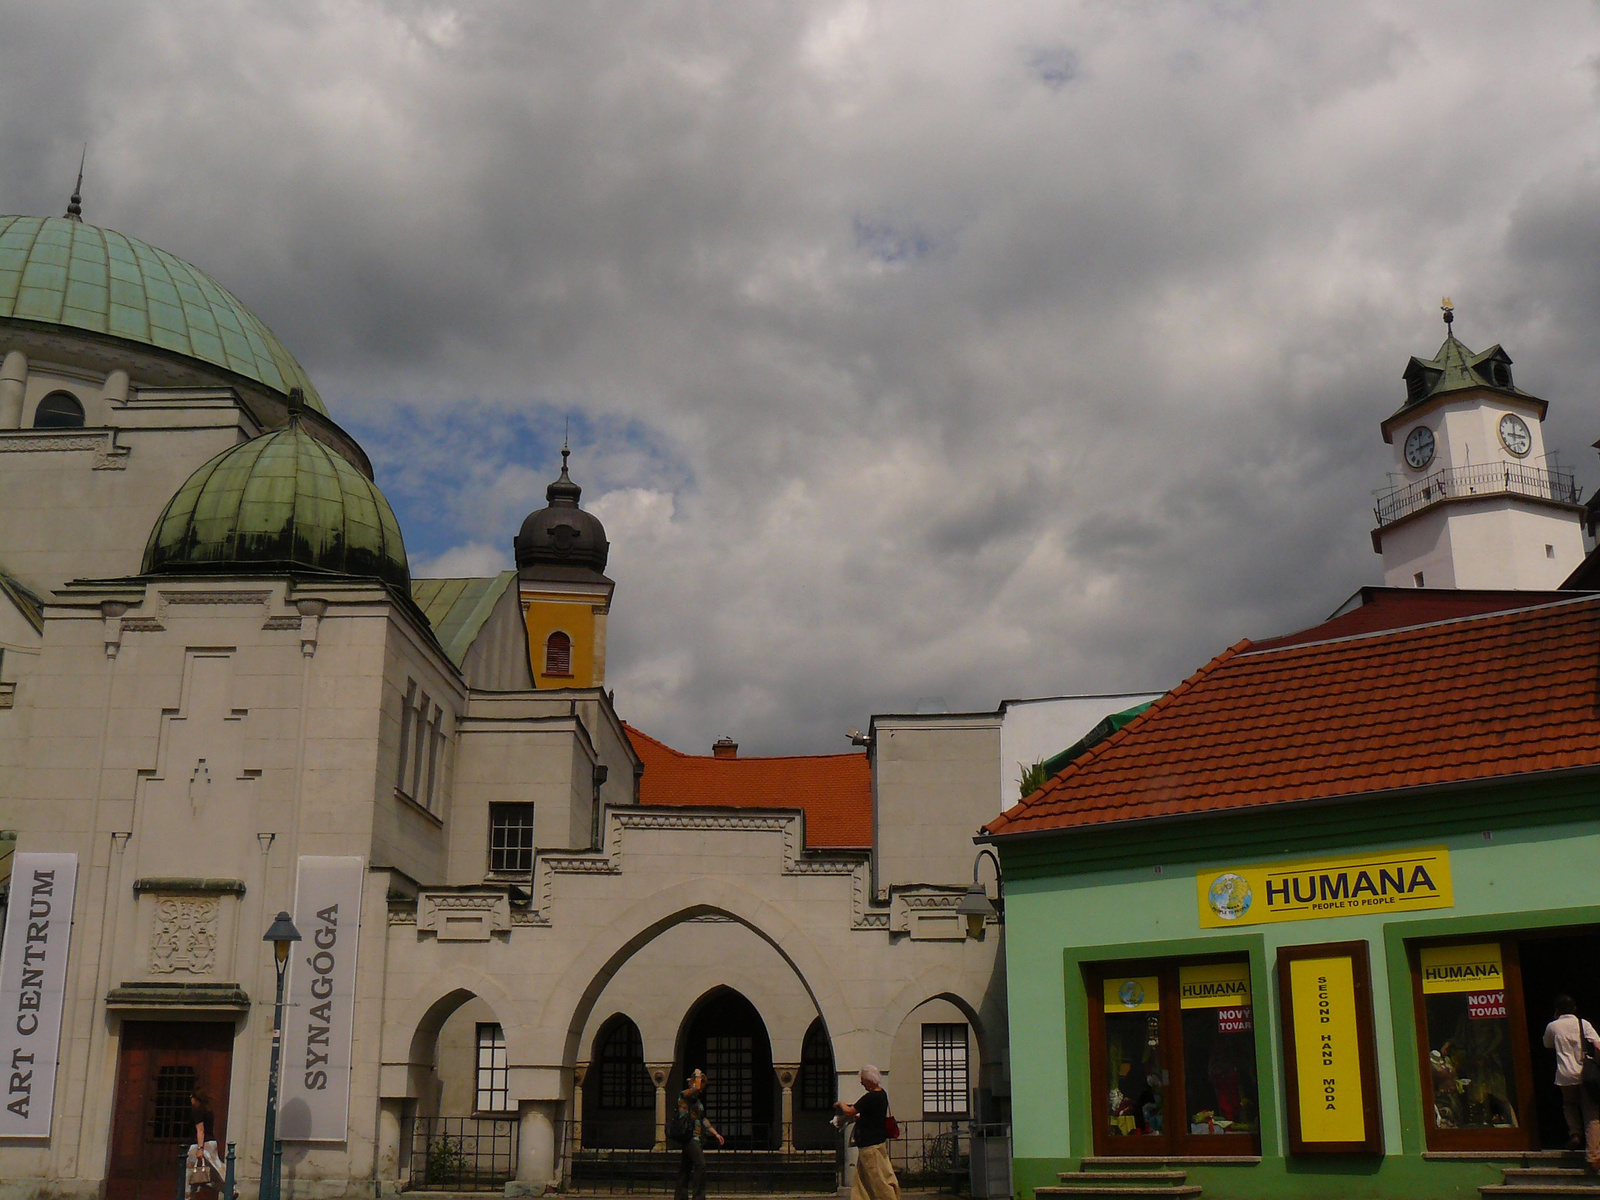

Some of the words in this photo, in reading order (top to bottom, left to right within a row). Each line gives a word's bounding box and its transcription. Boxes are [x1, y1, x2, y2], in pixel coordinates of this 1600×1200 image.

[1266, 865, 1437, 906] HUMANA
[1312, 901, 1345, 911] PEOPLE
[1347, 900, 1359, 908] TO
[1361, 896, 1396, 907] PEOPLE
[16, 869, 55, 1036] CENTRUM
[1425, 964, 1500, 980] HUMANA
[304, 903, 339, 1091] SYNAGÓGA
[1182, 981, 1247, 996] HUMANA
[1318, 976, 1330, 1023] SECOND
[1468, 992, 1504, 1005] NOVÝ
[1219, 1008, 1250, 1020] NOVÝ
[1470, 1007, 1506, 1017] TOVAR
[1220, 1021, 1251, 1031] TOVAR
[1321, 1034, 1332, 1066] HAND
[7, 1047, 35, 1119] ART
[1323, 1079, 1336, 1110] MODA
